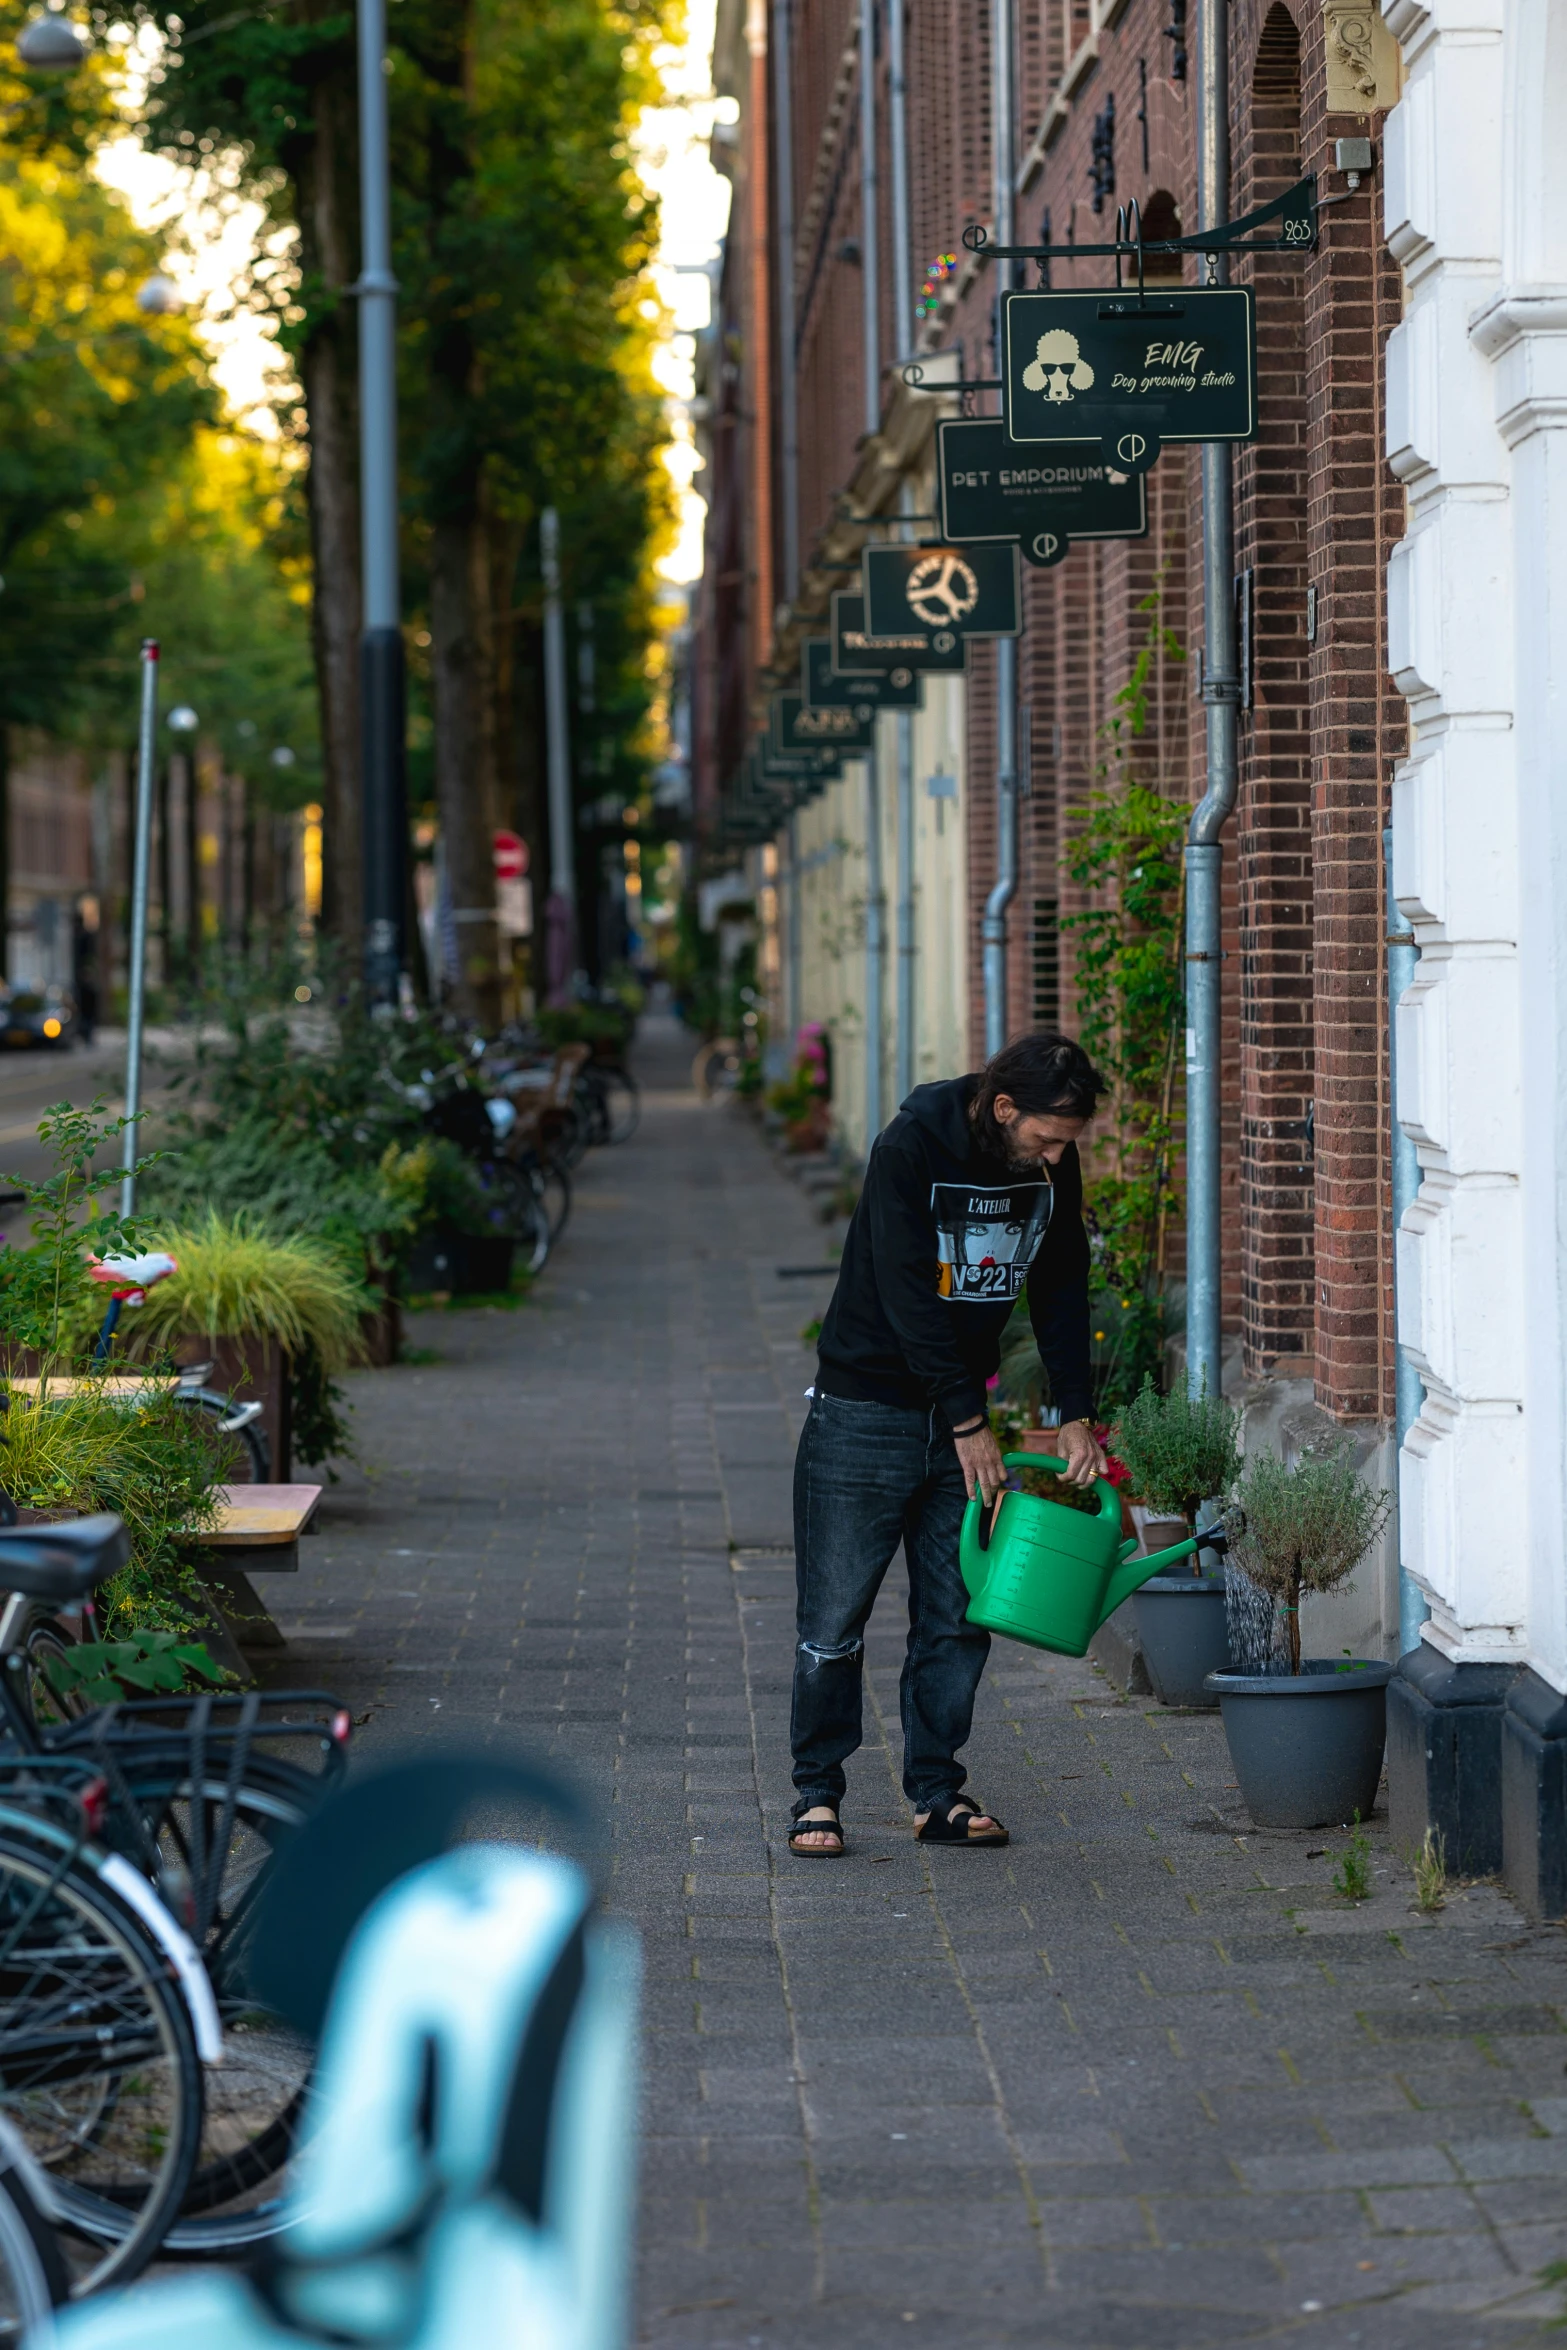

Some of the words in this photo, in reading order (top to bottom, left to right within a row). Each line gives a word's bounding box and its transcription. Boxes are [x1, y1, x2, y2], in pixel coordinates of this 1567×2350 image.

[1284, 219, 1311, 241] 263
[1144, 340, 1205, 374] EMG
[1111, 373, 1137, 394] Dog
[1139, 372, 1197, 394] grooming
[1200, 370, 1236, 387] studio
[951, 470, 991, 488] PET
[998, 465, 1104, 487] EMPORIUM
[967, 1197, 1011, 1215] L'ATELIER
